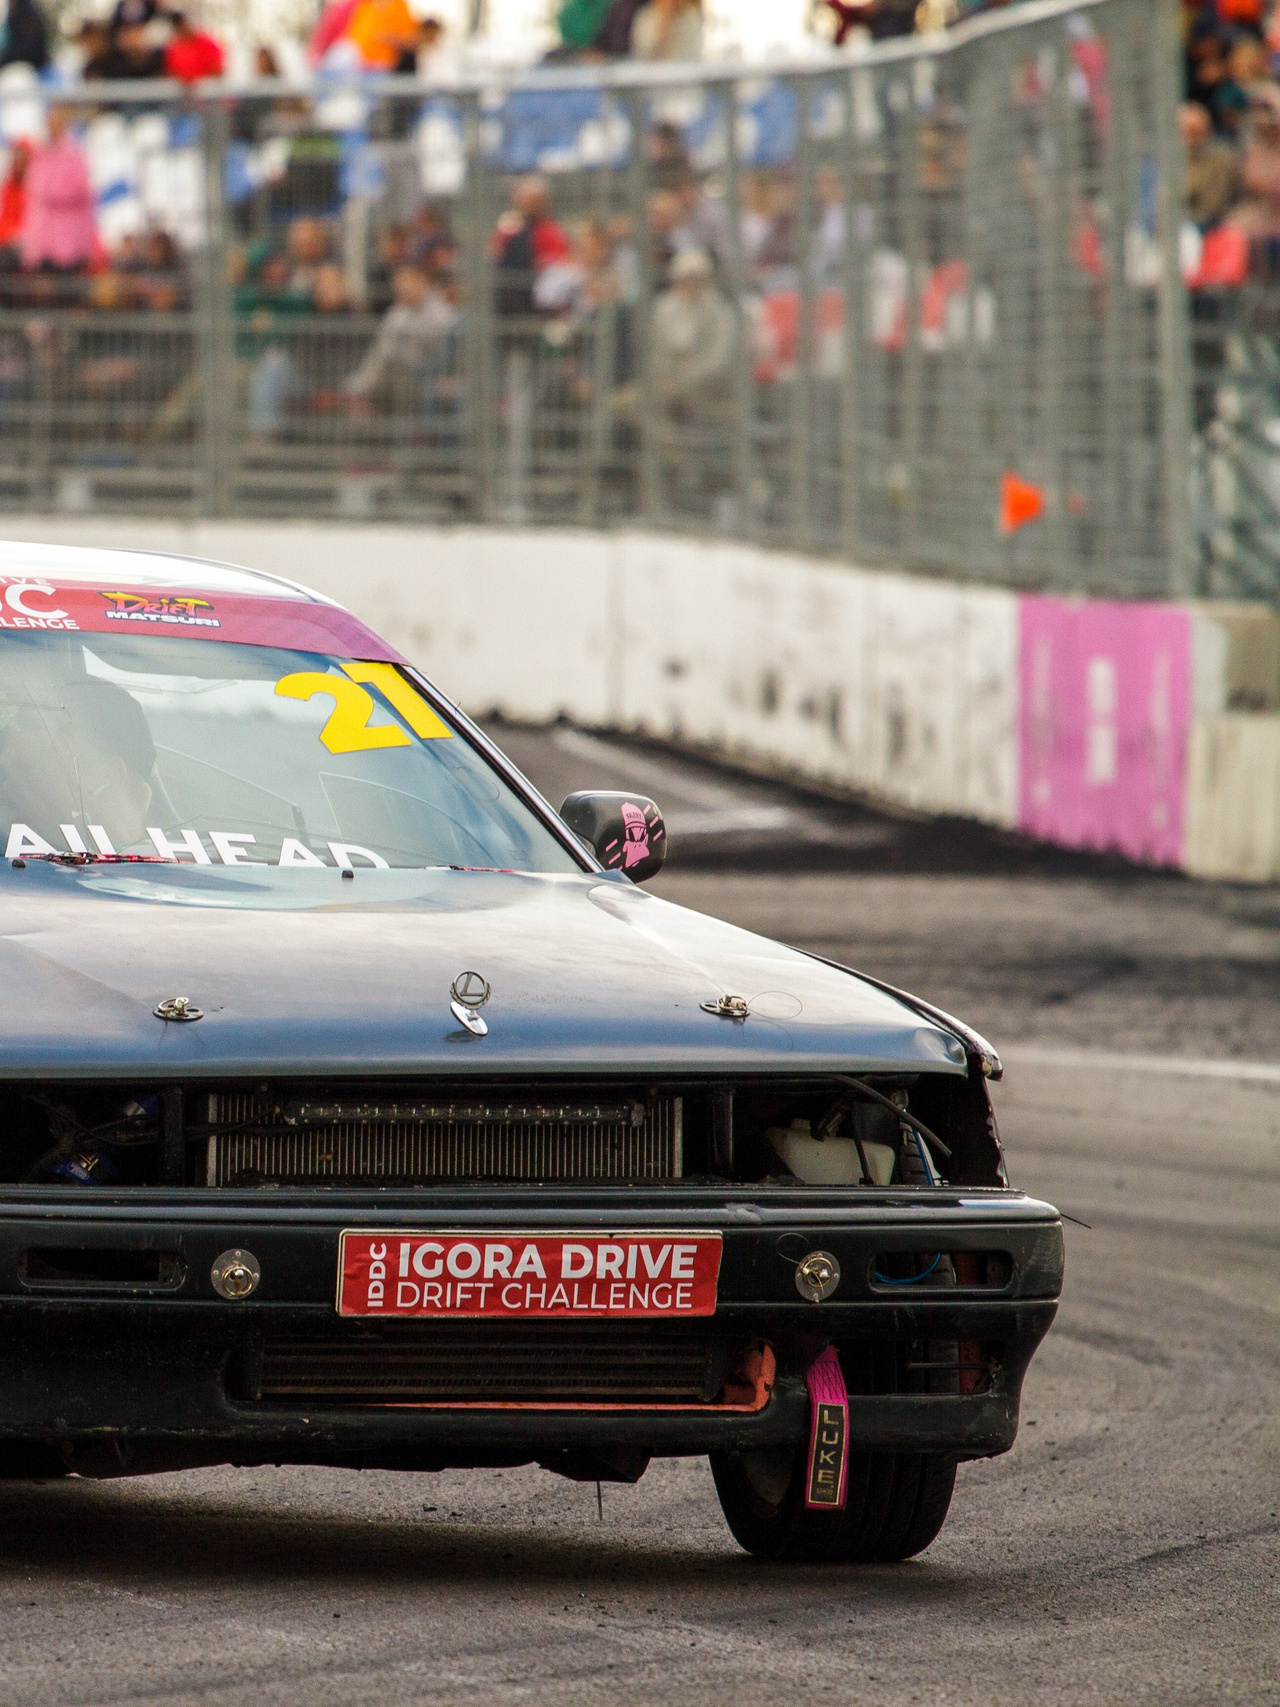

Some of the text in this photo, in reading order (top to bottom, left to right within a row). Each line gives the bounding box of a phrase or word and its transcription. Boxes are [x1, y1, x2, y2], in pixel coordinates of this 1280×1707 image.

[105, 610, 221, 628] MATSURI
[274, 662, 455, 755] 21
[367, 1242, 387, 1307] IDDC
[398, 1242, 698, 1280] IGORA DRIVE
[396, 1281, 694, 1309] DRIFT CHALLENGE
[817, 1409, 839, 1484] LUKE
